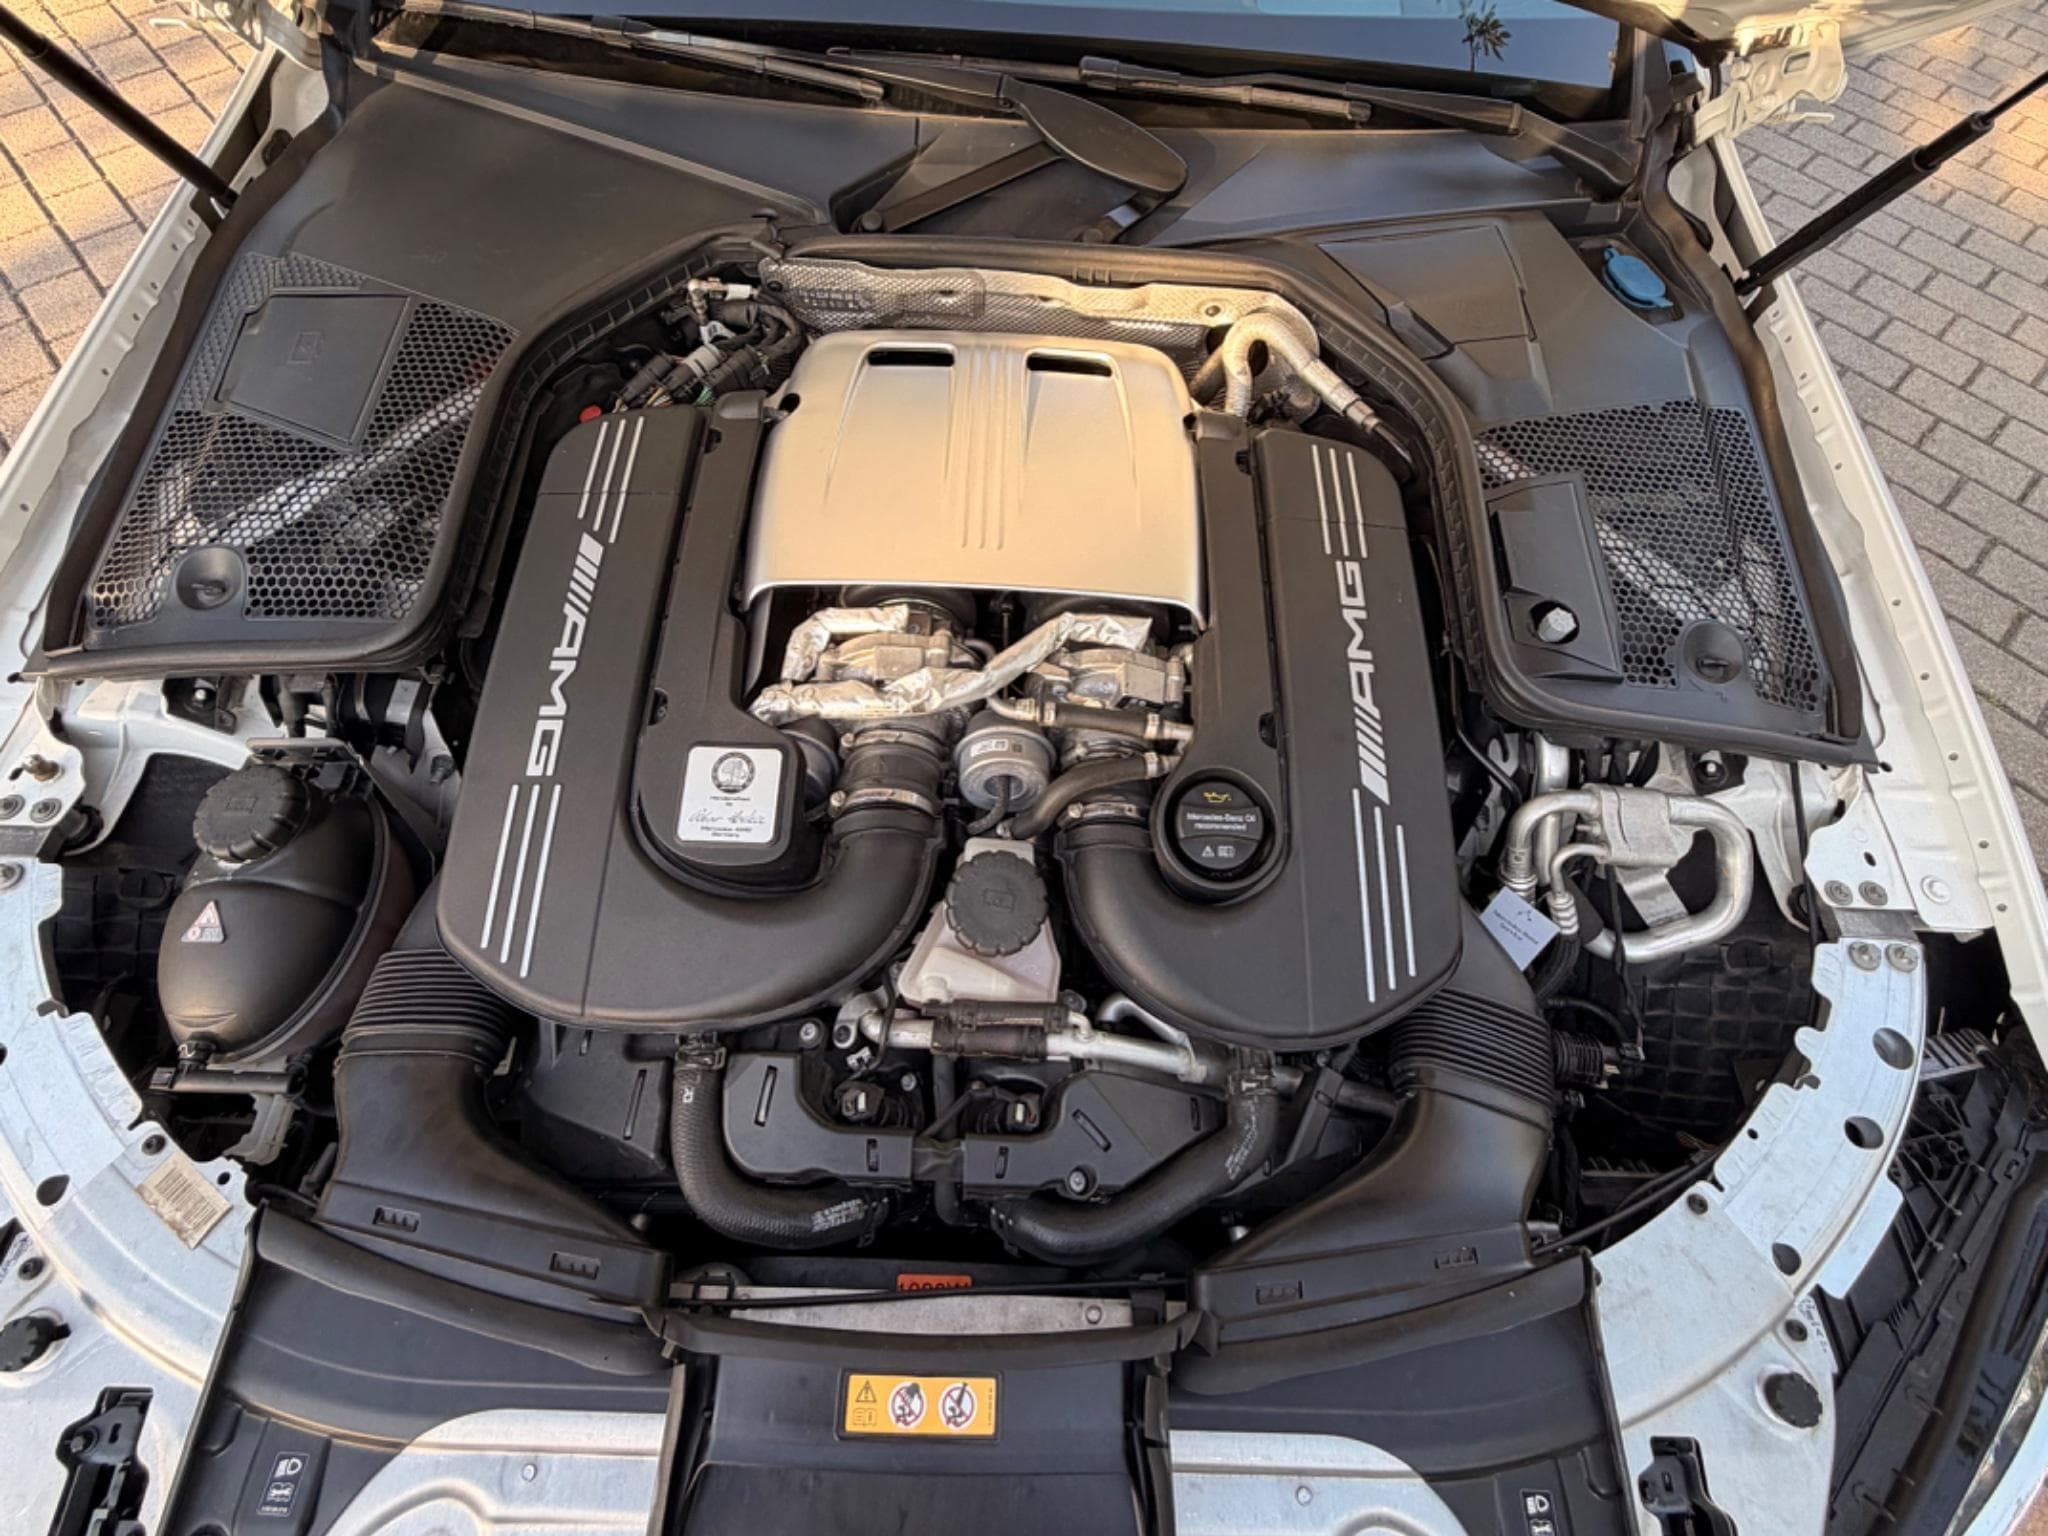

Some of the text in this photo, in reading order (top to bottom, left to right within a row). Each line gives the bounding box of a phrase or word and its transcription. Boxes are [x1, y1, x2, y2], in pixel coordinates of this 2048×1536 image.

[1335, 560, 1382, 721] AMG
[525, 602, 587, 777] AMG
[1186, 812, 1244, 822] Mercedes-Benz
[1194, 822, 1247, 831] recommended
